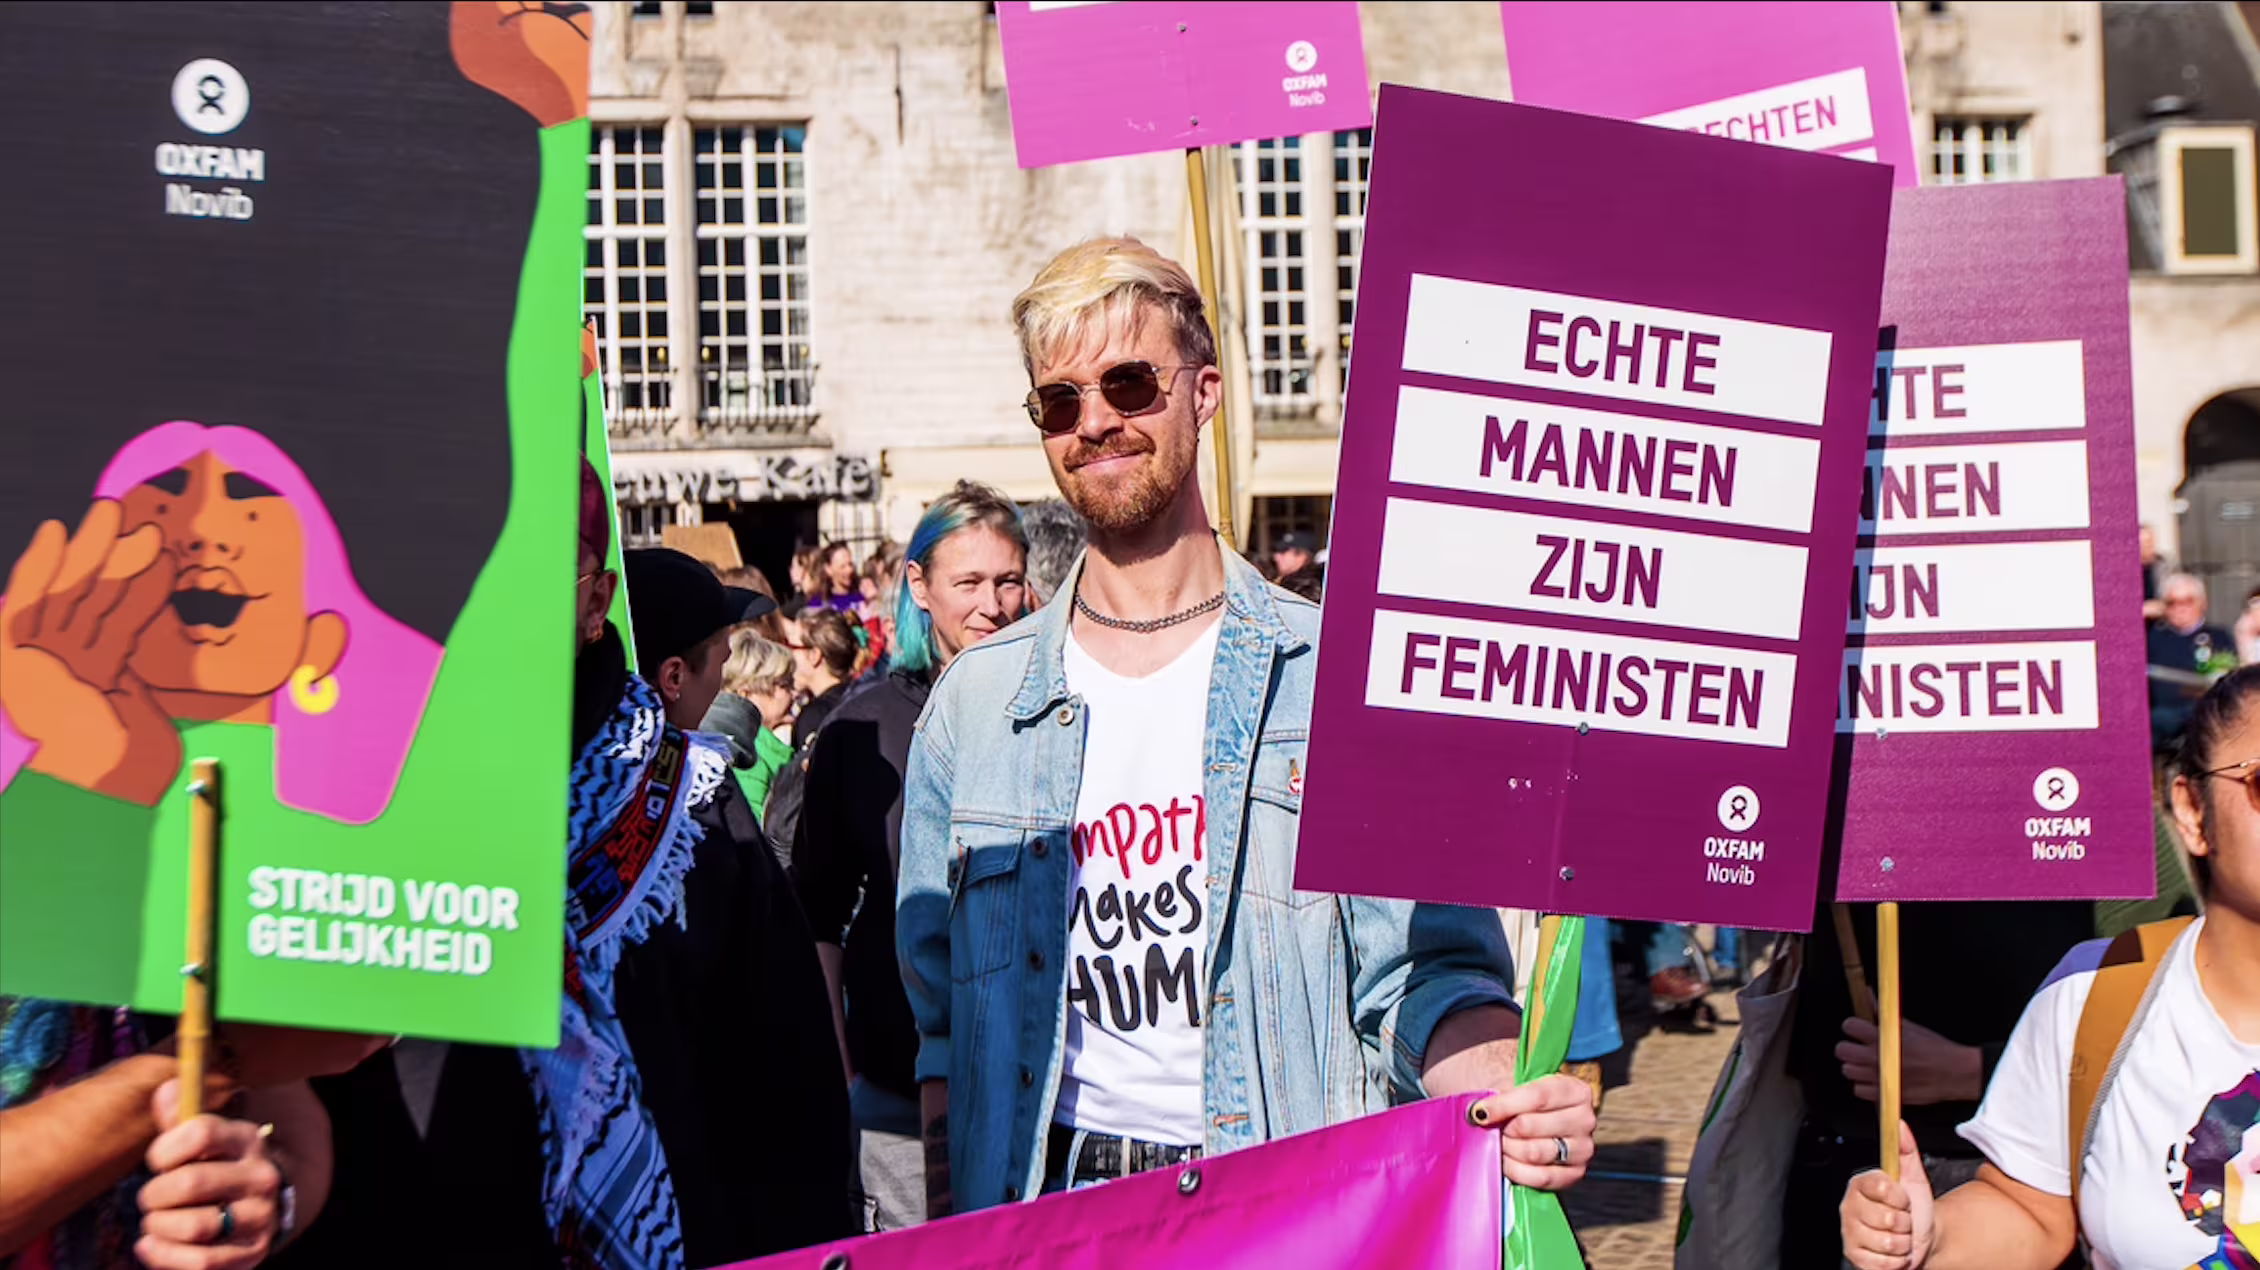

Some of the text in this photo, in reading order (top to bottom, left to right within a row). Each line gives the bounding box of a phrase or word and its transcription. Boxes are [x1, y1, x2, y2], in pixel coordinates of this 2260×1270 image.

[1281, 73, 1328, 92] OXFAM
[1289, 92, 1326, 107] Novib
[155, 142, 265, 181] OXFAM
[165, 183, 254, 220] Novib
[1523, 308, 1722, 396] ECHTE
[1478, 414, 1738, 508] MANNEN
[1529, 534, 1664, 609] ZIJN
[1399, 631, 1766, 730] FEMINISTEN
[1835, 659, 2064, 720] NISTEN
[2024, 817, 2092, 838] OXFAM
[1703, 836, 1765, 861] OXFAM
[2031, 840, 2086, 861] Novib
[1706, 862, 1755, 887] Novib
[247, 865, 521, 932] STRIJD VOOR
[247, 913, 494, 976] GELIJKHEID
